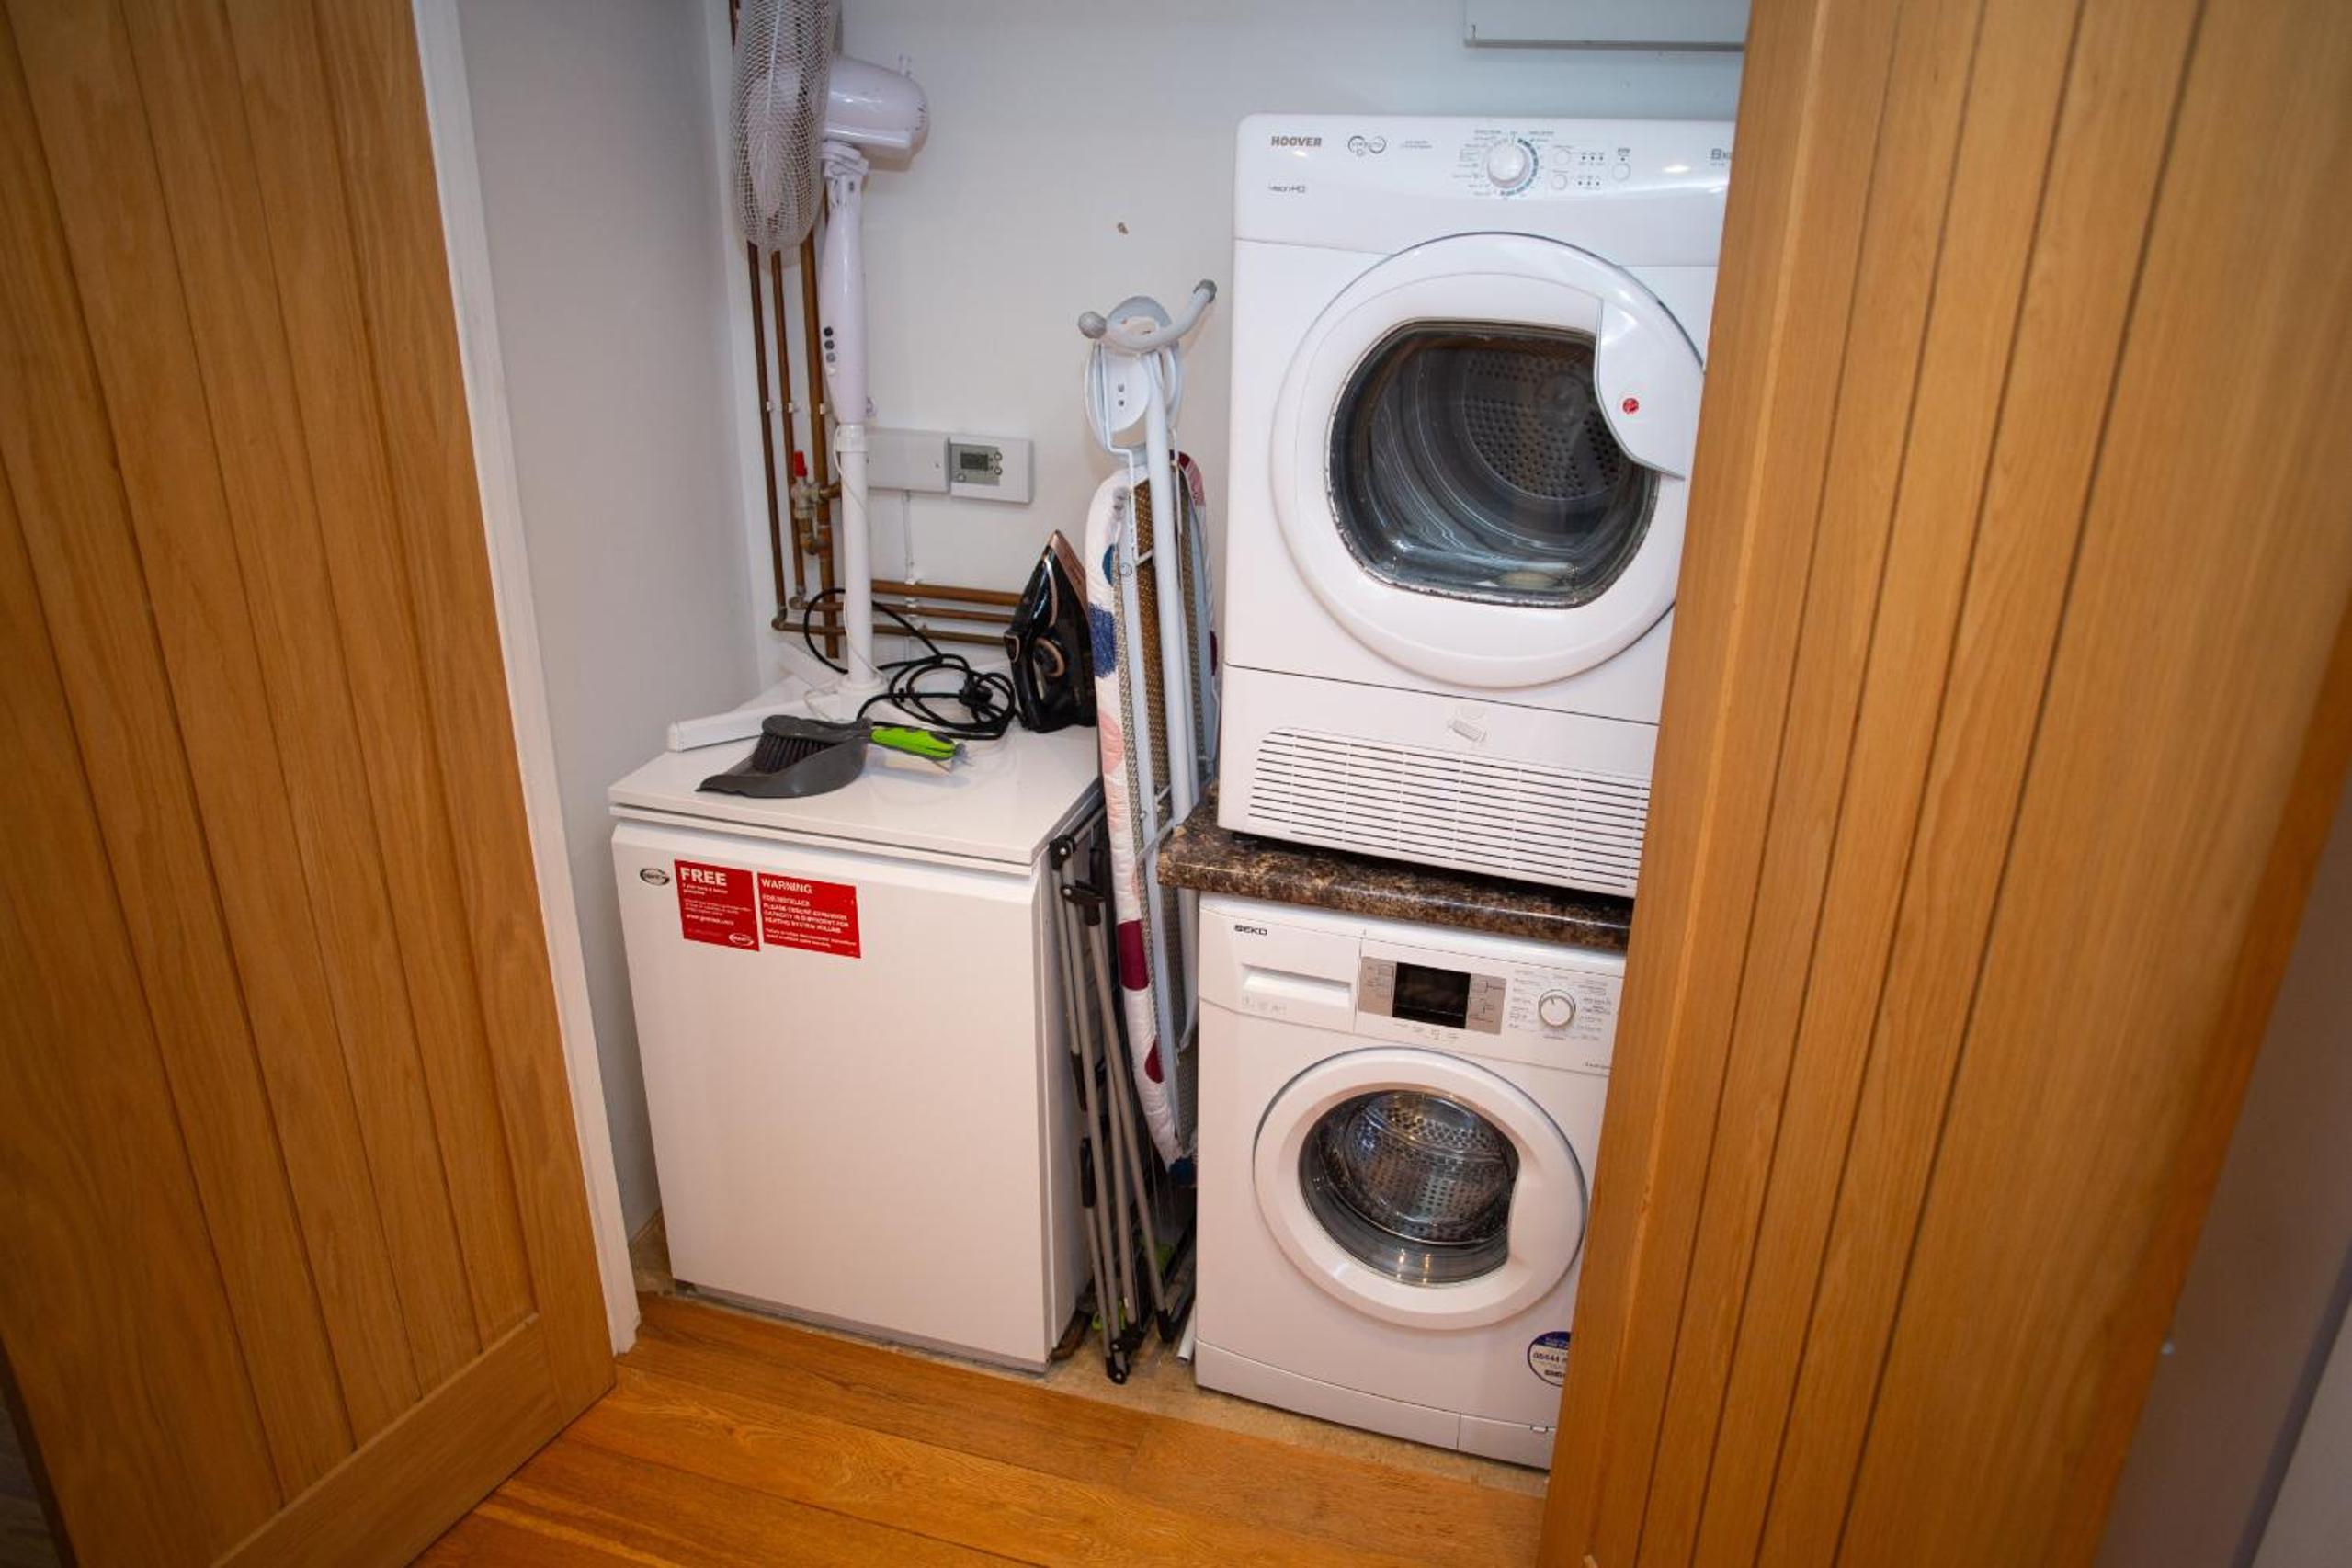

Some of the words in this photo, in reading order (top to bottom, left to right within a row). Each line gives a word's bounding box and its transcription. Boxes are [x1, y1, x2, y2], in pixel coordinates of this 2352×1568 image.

[1271, 137, 1322, 147] HOOVER
[680, 867, 728, 887] FREE
[761, 878, 813, 894] WARNING
